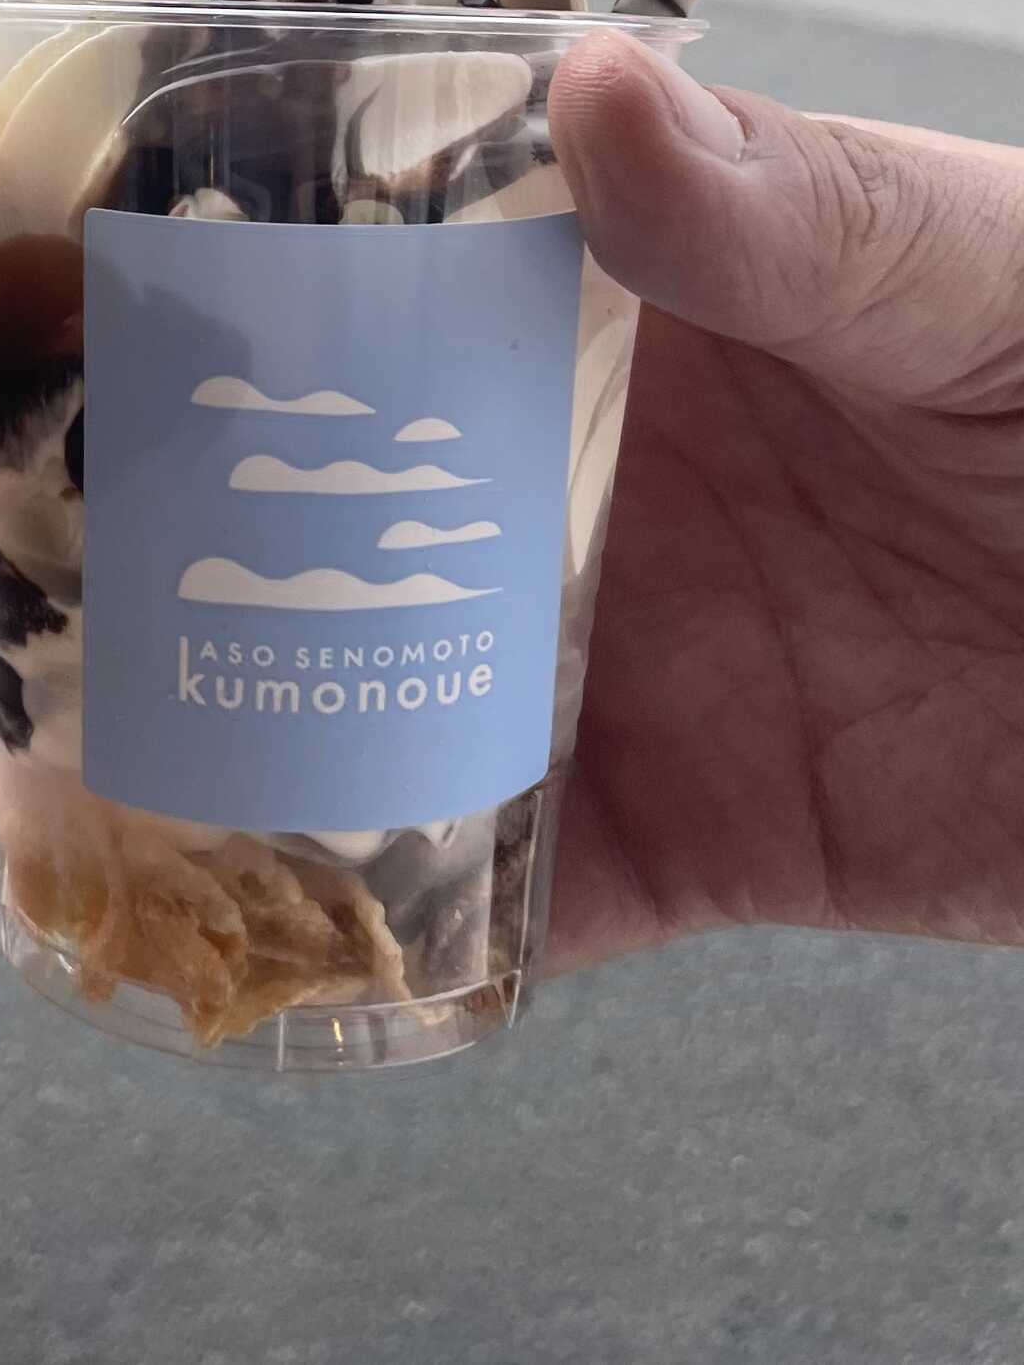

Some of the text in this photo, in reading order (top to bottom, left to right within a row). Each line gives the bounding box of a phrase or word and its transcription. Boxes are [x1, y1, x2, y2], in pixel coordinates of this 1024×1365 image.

[178, 635, 494, 714] kumonoue
[199, 630, 494, 670] ASO SENOMOTO
